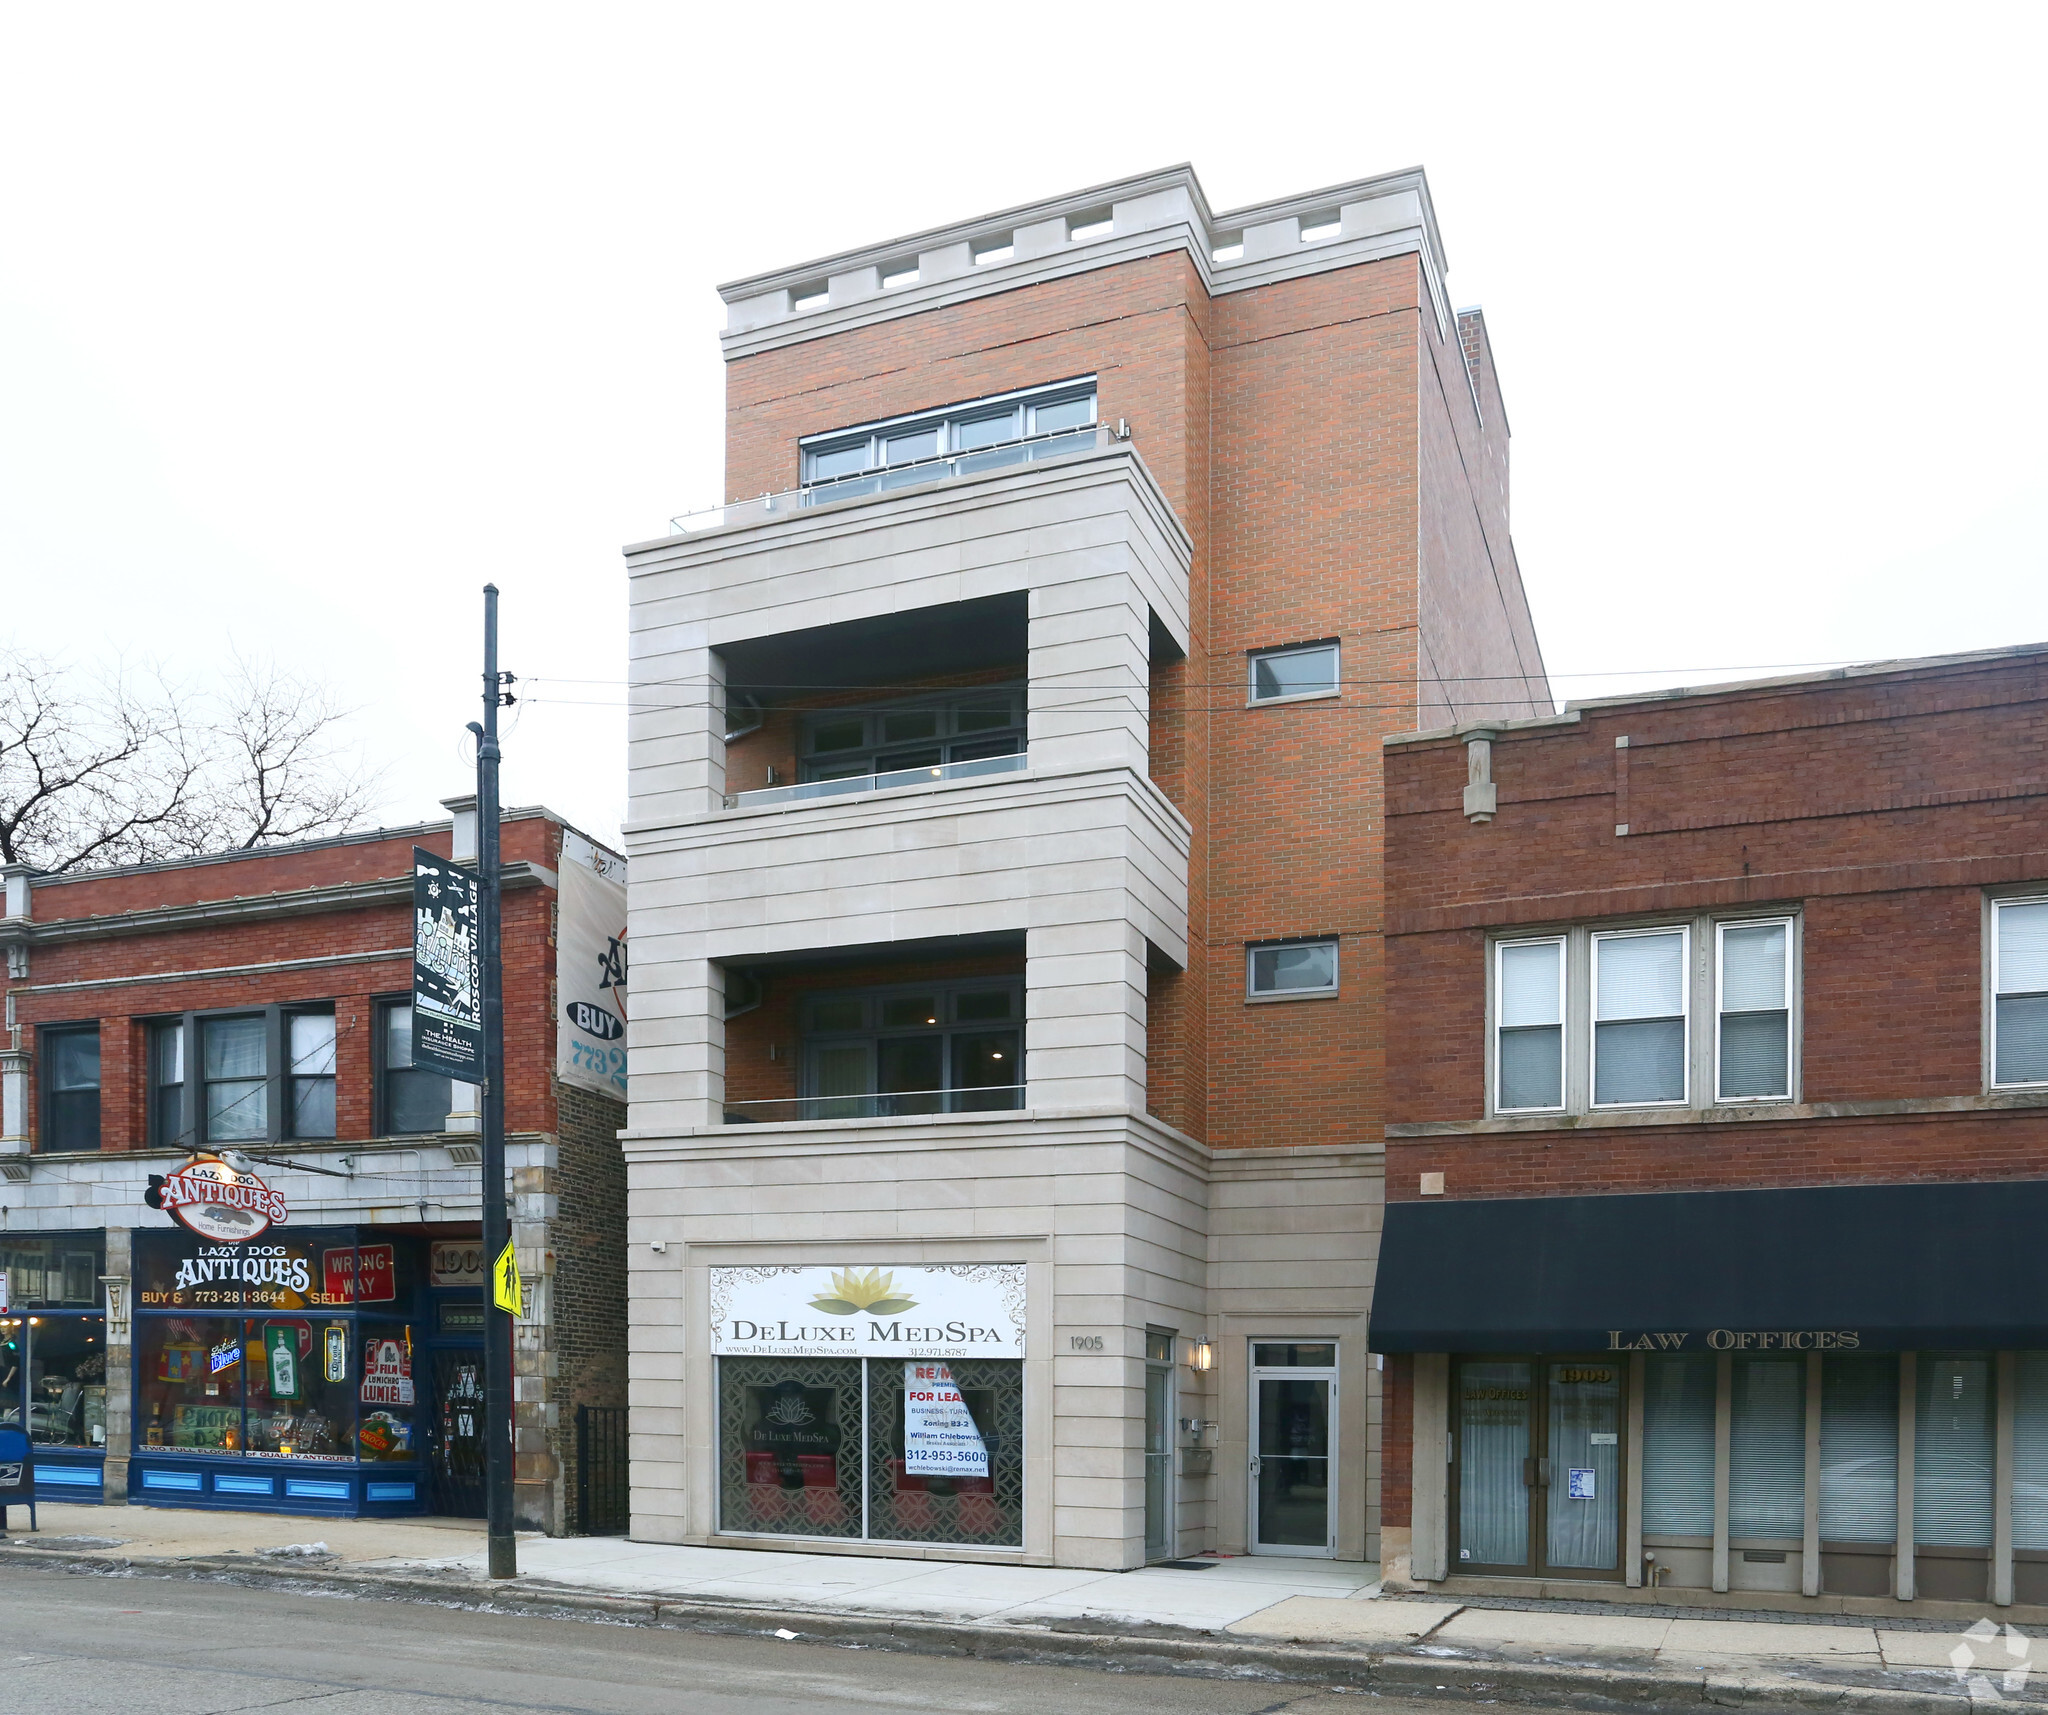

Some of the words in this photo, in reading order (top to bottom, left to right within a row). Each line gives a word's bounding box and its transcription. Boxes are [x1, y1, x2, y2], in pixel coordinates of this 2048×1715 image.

[469, 880, 479, 949] VILLAGE
[471, 953, 481, 1023] ROSCOE
[577, 1003, 616, 1039] BUY
[425, 1029, 441, 1039] THE
[442, 1034, 472, 1047] HEALTH
[571, 1040, 608, 1075] 773
[192, 1168, 223, 1181] LAZ
[159, 1174, 288, 1223] ANTIQUES
[198, 1222, 215, 1232] Home
[217, 1223, 251, 1236] Furnishings
[198, 1246, 240, 1258] LAZY
[247, 1246, 287, 1257] DOG
[175, 1258, 310, 1293] ANTIQUES
[141, 1292, 169, 1303] BUY
[172, 1292, 184, 1304] &
[310, 1292, 350, 1304] SELL
[1070, 1336, 1104, 1351] 1905
[210, 1347, 241, 1372] Blue
[908, 1347, 967, 1358] 312.971.8787
[380, 1364, 398, 1374] FILM
[1558, 1368, 1611, 1384] 1909
[909, 1392, 935, 1402] FOR
[923, 1420, 949, 1428] Zoning
[198, 1449, 241, 1457] FLOORS
[259, 1452, 301, 1460] QUALITY
[302, 1454, 354, 1463] ANTIQUES
[906, 1449, 987, 1462] 312-953-5600
[908, 1465, 986, 1473] wchlebowski@remax.net
